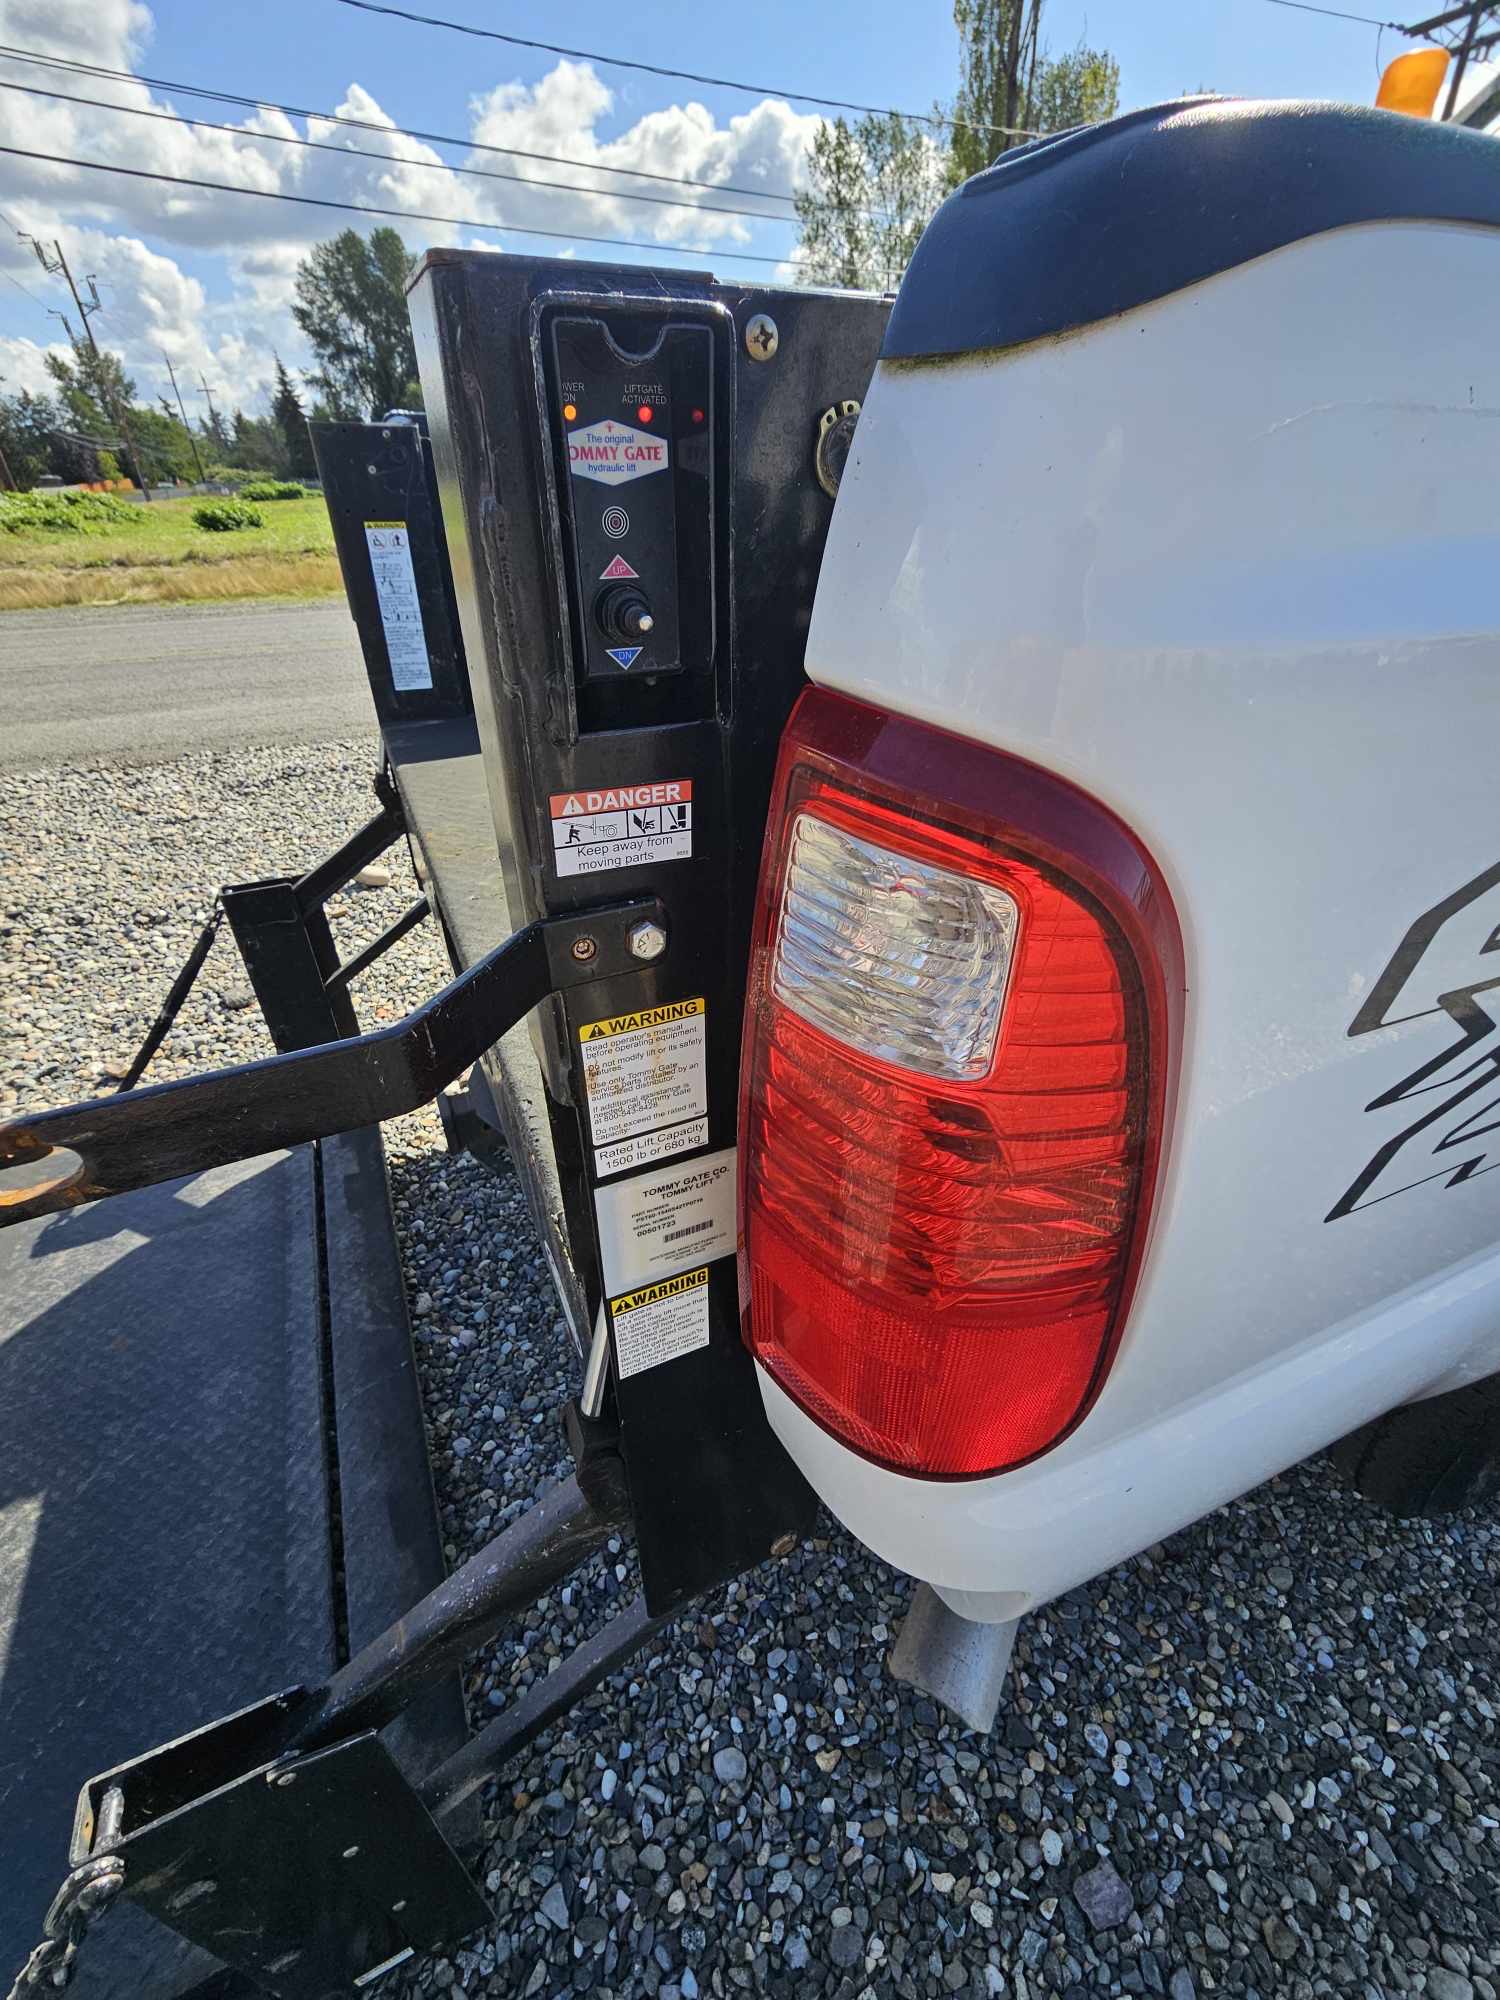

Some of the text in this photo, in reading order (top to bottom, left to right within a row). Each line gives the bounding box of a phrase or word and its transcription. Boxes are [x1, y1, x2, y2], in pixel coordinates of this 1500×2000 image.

[562, 383, 584, 392] WER
[624, 384, 664, 394] LIFTGATE
[622, 395, 666, 404] ACTIVATED
[586, 434, 634, 445] The original
[569, 446, 662, 460] OMMY GATE
[588, 464, 636, 473] hydraulic lift
[612, 566, 626, 575] UP
[618, 651, 632, 660] DN
[587, 784, 680, 811] DANGER
[578, 835, 673, 857] Keep away from
[578, 851, 654, 872] moving parts
[608, 1002, 698, 1033] WARNING
[585, 1023, 682, 1051] Read operator's manual
[586, 1048, 612, 1059] before
[614, 1038, 653, 1051] operating
[587, 1062, 599, 1071] Do
[602, 1059, 615, 1067] not
[617, 1052, 643, 1063] modify
[679, 1038, 702, 1048] safety
[588, 1065, 623, 1077] features.
[590, 1084, 619, 1095] service
[621, 1078, 641, 1088] parts
[643, 1067, 675, 1080] installed
[608, 1076, 624, 1084] only
[628, 1067, 656, 1079] Tommy
[658, 1062, 677, 1071] Gate
[591, 1075, 675, 1101] authorized distributor.
[600, 1095, 638, 1111] additional
[640, 1085, 680, 1100] assistance
[593, 1087, 690, 1118] needed, call Tommy Gate
[623, 1115, 651, 1127] exceed
[667, 1105, 686, 1114] rated
[600, 1123, 704, 1160] Rated Lift Capacity
[606, 1135, 700, 1168] 1500 lb or 680 kg
[643, 1166, 730, 1198] TOMMY GATE CO.
[661, 1180, 714, 1200] TOMMY LIFT
[636, 1220, 676, 1238] 00501723
[632, 1270, 706, 1306] WARNING
